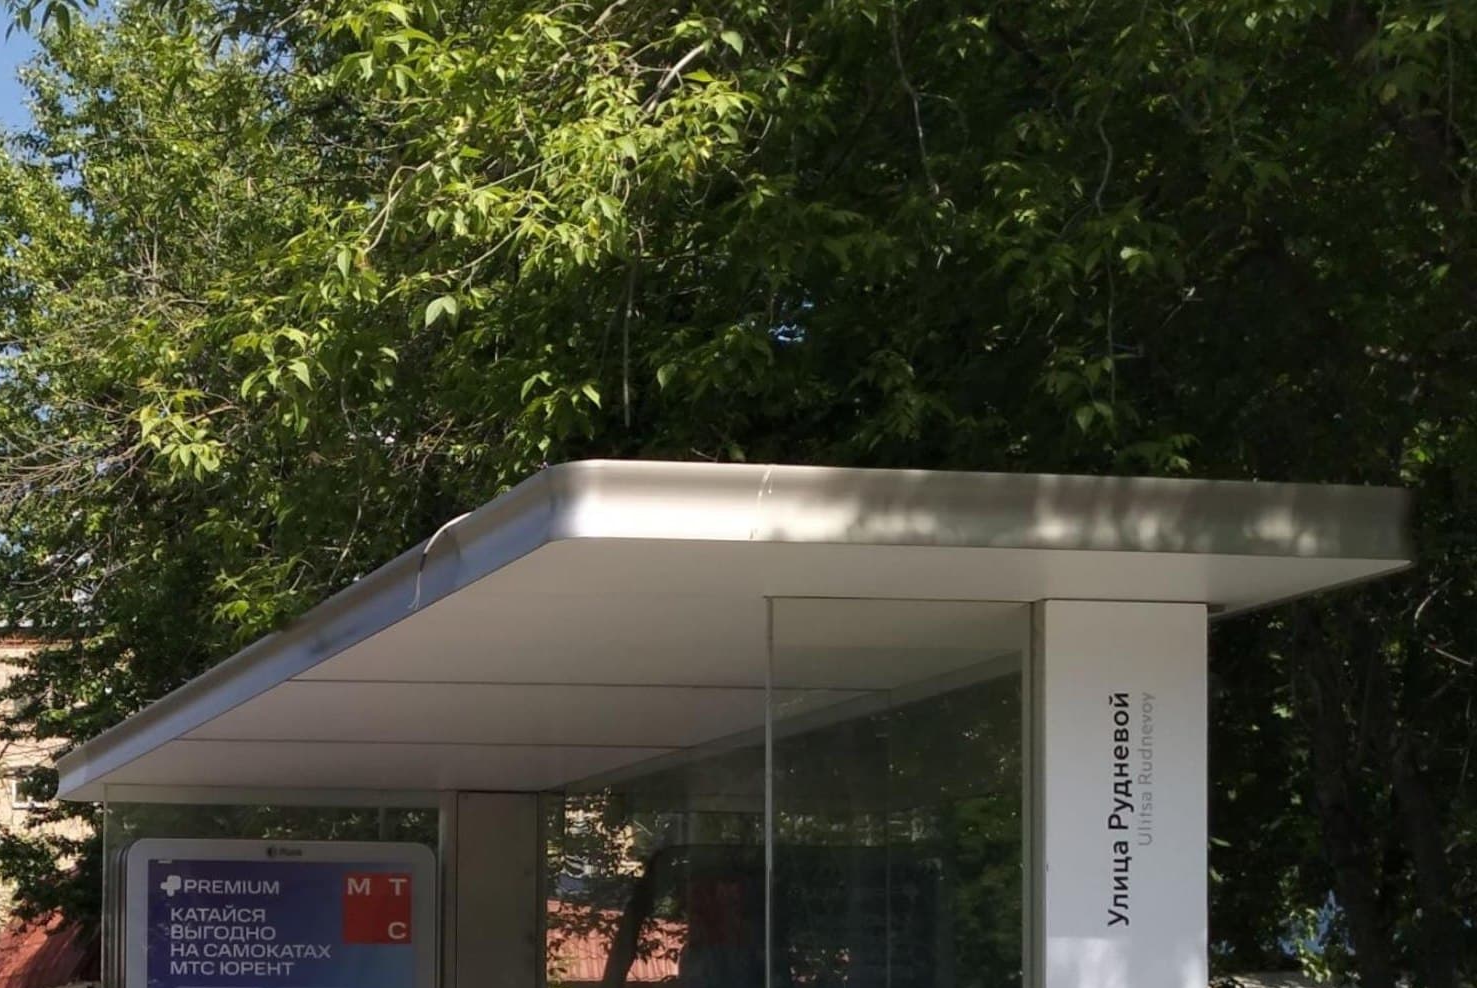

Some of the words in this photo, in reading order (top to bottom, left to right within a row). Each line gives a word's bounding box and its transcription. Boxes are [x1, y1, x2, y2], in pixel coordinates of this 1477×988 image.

[1138, 691, 1156, 784] Rudnevoy
[1108, 692, 1134, 830] Рудневой
[1138, 791, 1153, 847] Ulitsa
[184, 879, 280, 894] PREMIUM
[1108, 840, 1132, 926] Улица
[171, 905, 266, 922] КАТАЙСЯ
[171, 926, 276, 942] ВЫГОДНО
[171, 944, 199, 958] НА
[203, 944, 331, 959] САМОКАТАХ
[171, 961, 215, 976] МТС
[220, 961, 294, 976] ЮРЕНТ
